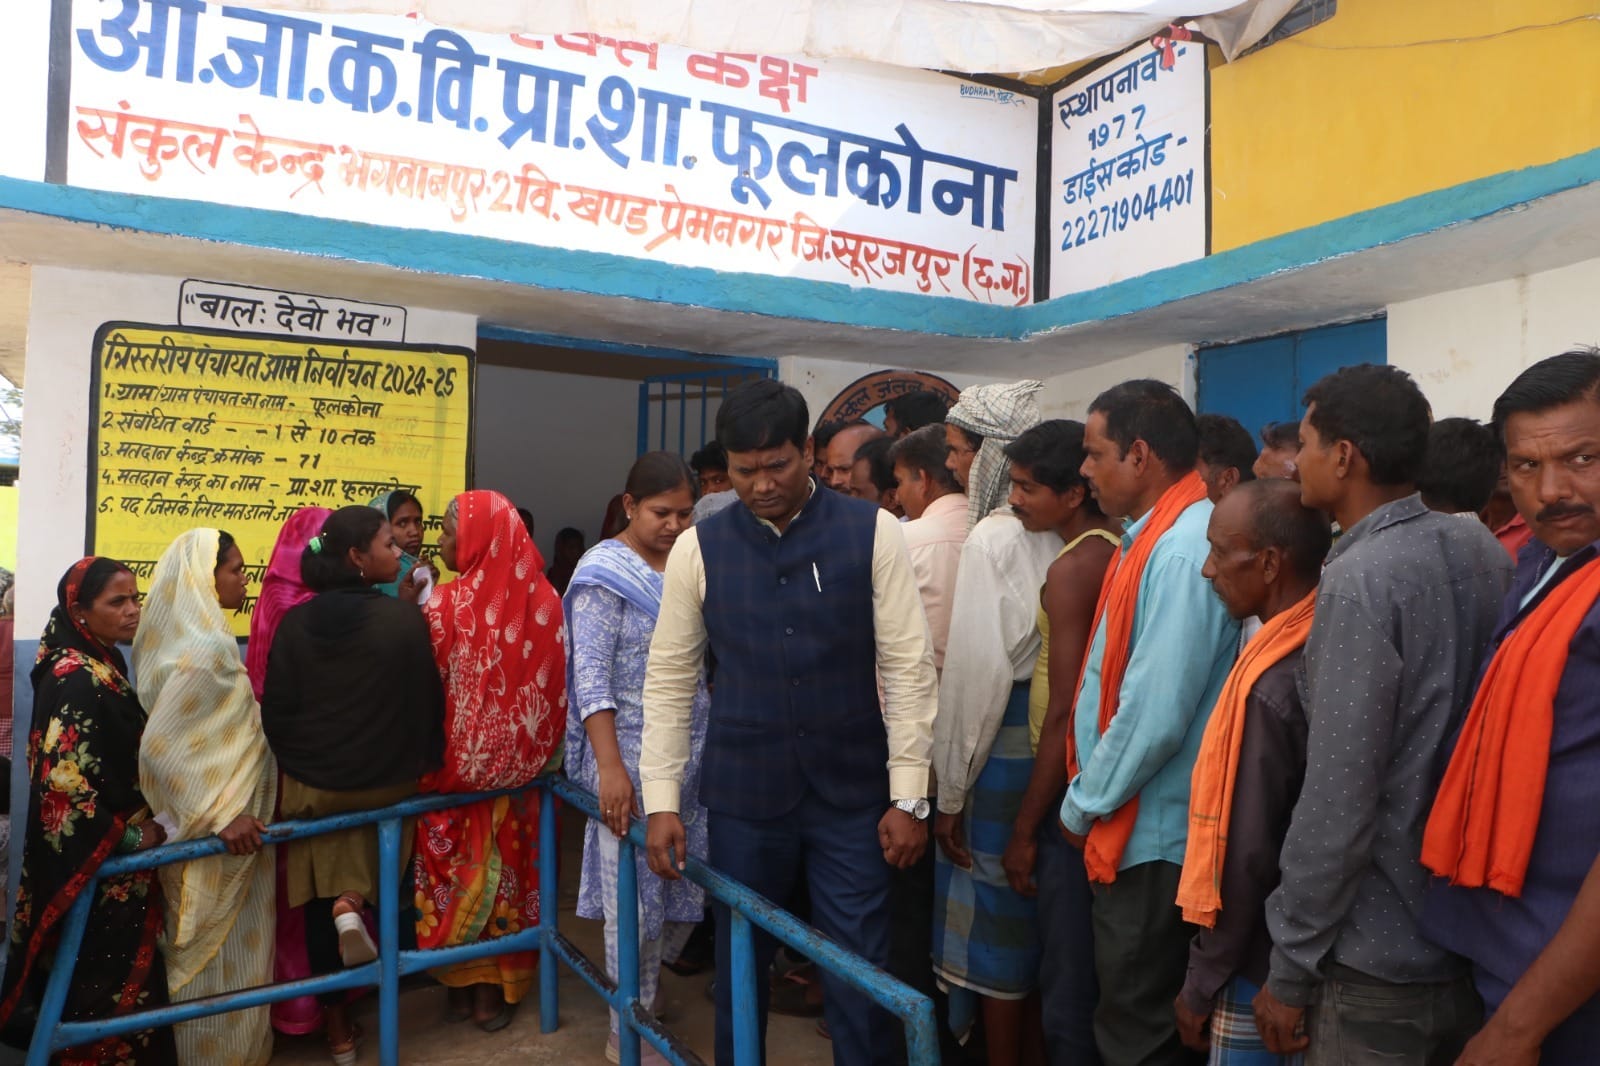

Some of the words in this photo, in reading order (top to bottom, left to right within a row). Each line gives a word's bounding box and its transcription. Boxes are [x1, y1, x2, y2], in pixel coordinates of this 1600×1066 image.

[1088, 103, 1146, 151] 1977
[75, 100, 231, 181] संकुल
[232, 113, 336, 199] केन्द्र
[564, 184, 658, 236] खण्ड
[643, 183, 788, 262] प्रेमनगर
[700, 122, 1019, 232] फूलकोना
[1061, 168, 1194, 252] 22271904401
[275, 294, 329, 332] देवो
[104, 333, 196, 376] त्रिस्तरीय
[195, 343, 267, 381] पंचायत
[303, 347, 382, 390] निर्वाचन
[381, 363, 458, 398] 2024-25
[241, 392, 261, 409] का
[259, 394, 288, 411] नाम
[310, 395, 384, 419] फूलकोना
[182, 412, 217, 435] वार्ड
[290, 419, 311, 443] से
[319, 428, 338, 445] 10
[341, 428, 376, 446] तक
[116, 442, 176, 461] मतदान
[176, 439, 214, 465] केन्द्र
[211, 445, 266, 465] क्रमांक
[300, 453, 321, 469] 71
[117, 469, 173, 487] मतदान
[175, 467, 207, 492] केन्द्र
[206, 474, 229, 491] का
[230, 475, 266, 492] नाम
[120, 497, 144, 517] पद
[144, 492, 193, 517] जिसके
